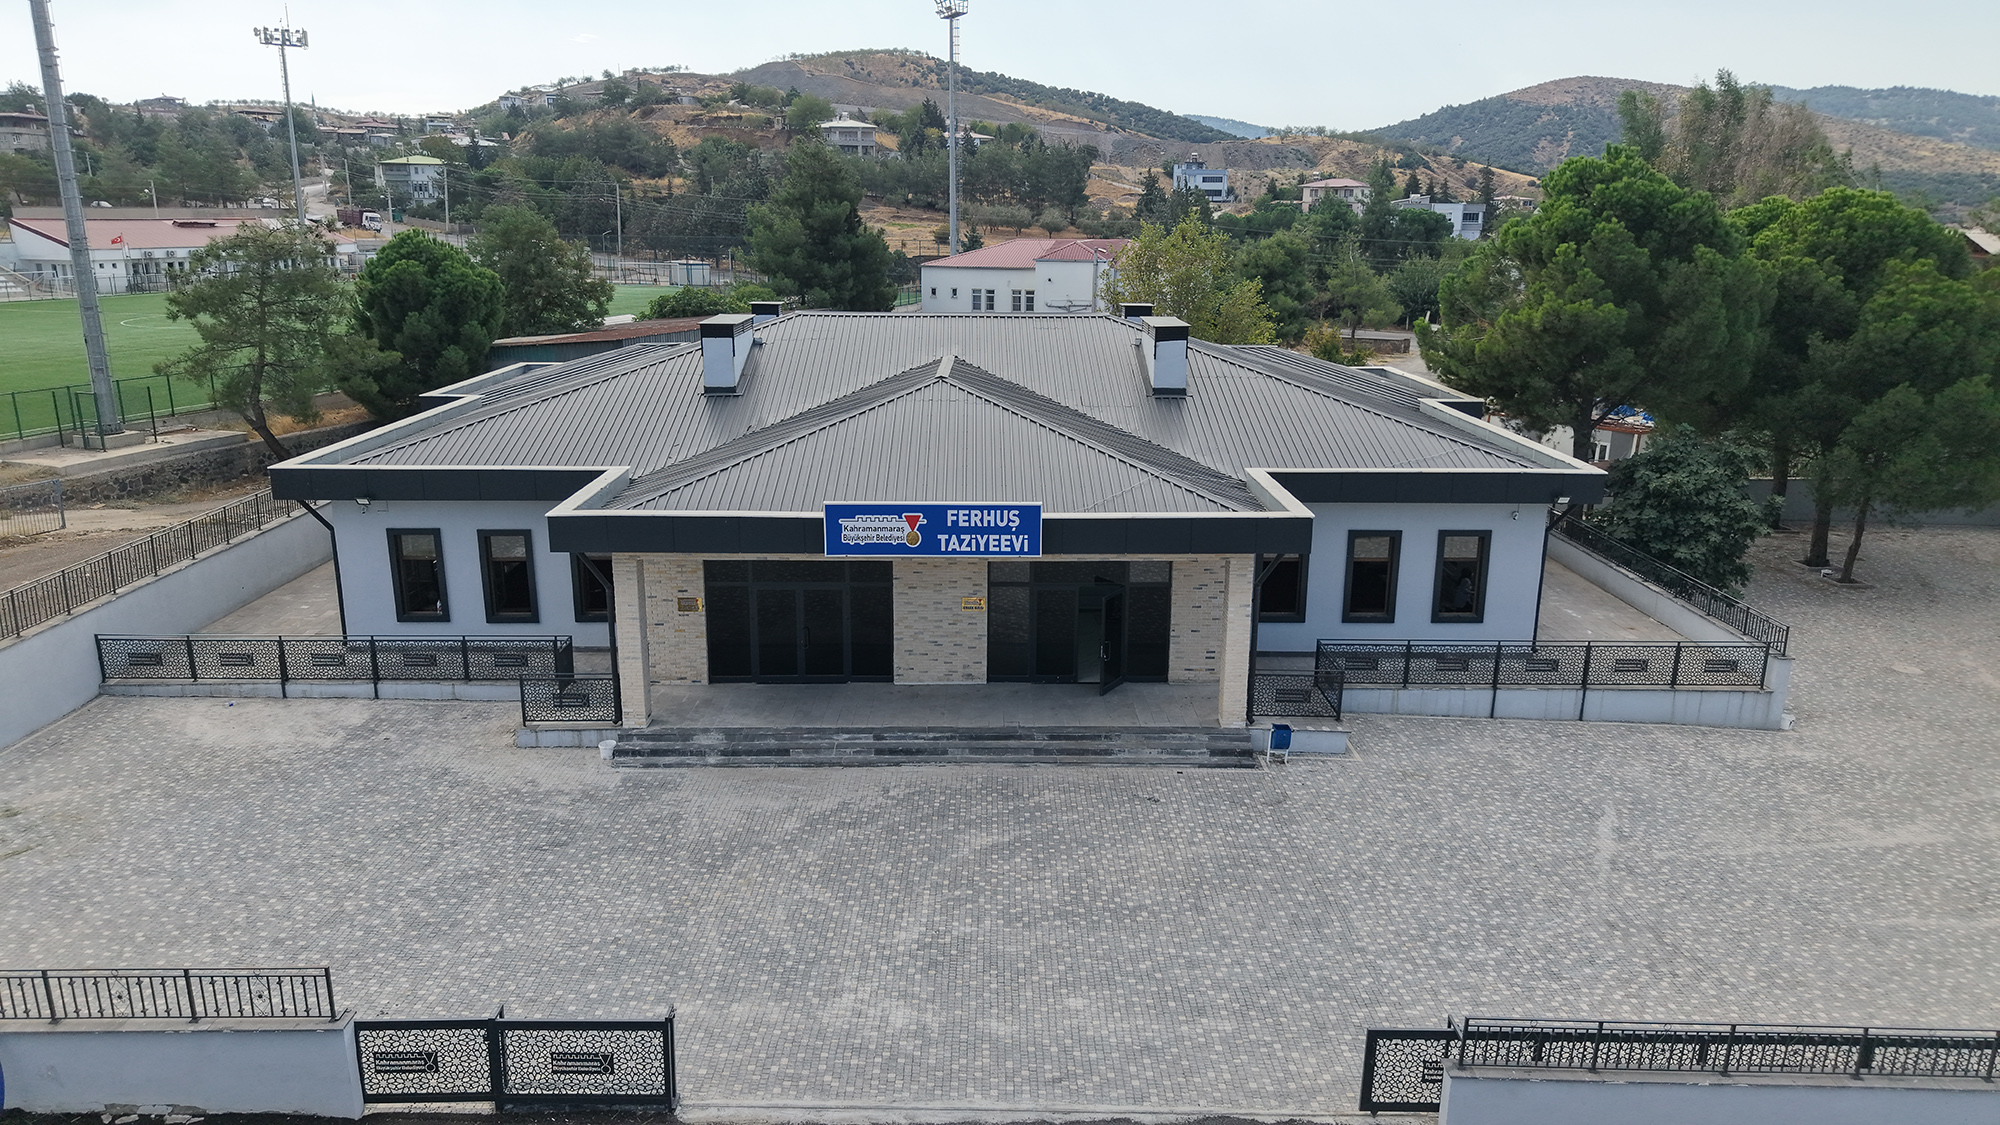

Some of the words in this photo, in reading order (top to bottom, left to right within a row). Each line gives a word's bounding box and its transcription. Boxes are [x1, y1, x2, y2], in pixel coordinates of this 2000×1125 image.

[946, 509, 1020, 532] FERHUŞ
[843, 524, 905, 534] Kahramanmaraş
[843, 534, 875, 544] Büyükşehir
[875, 534, 905, 544] Belediyesi
